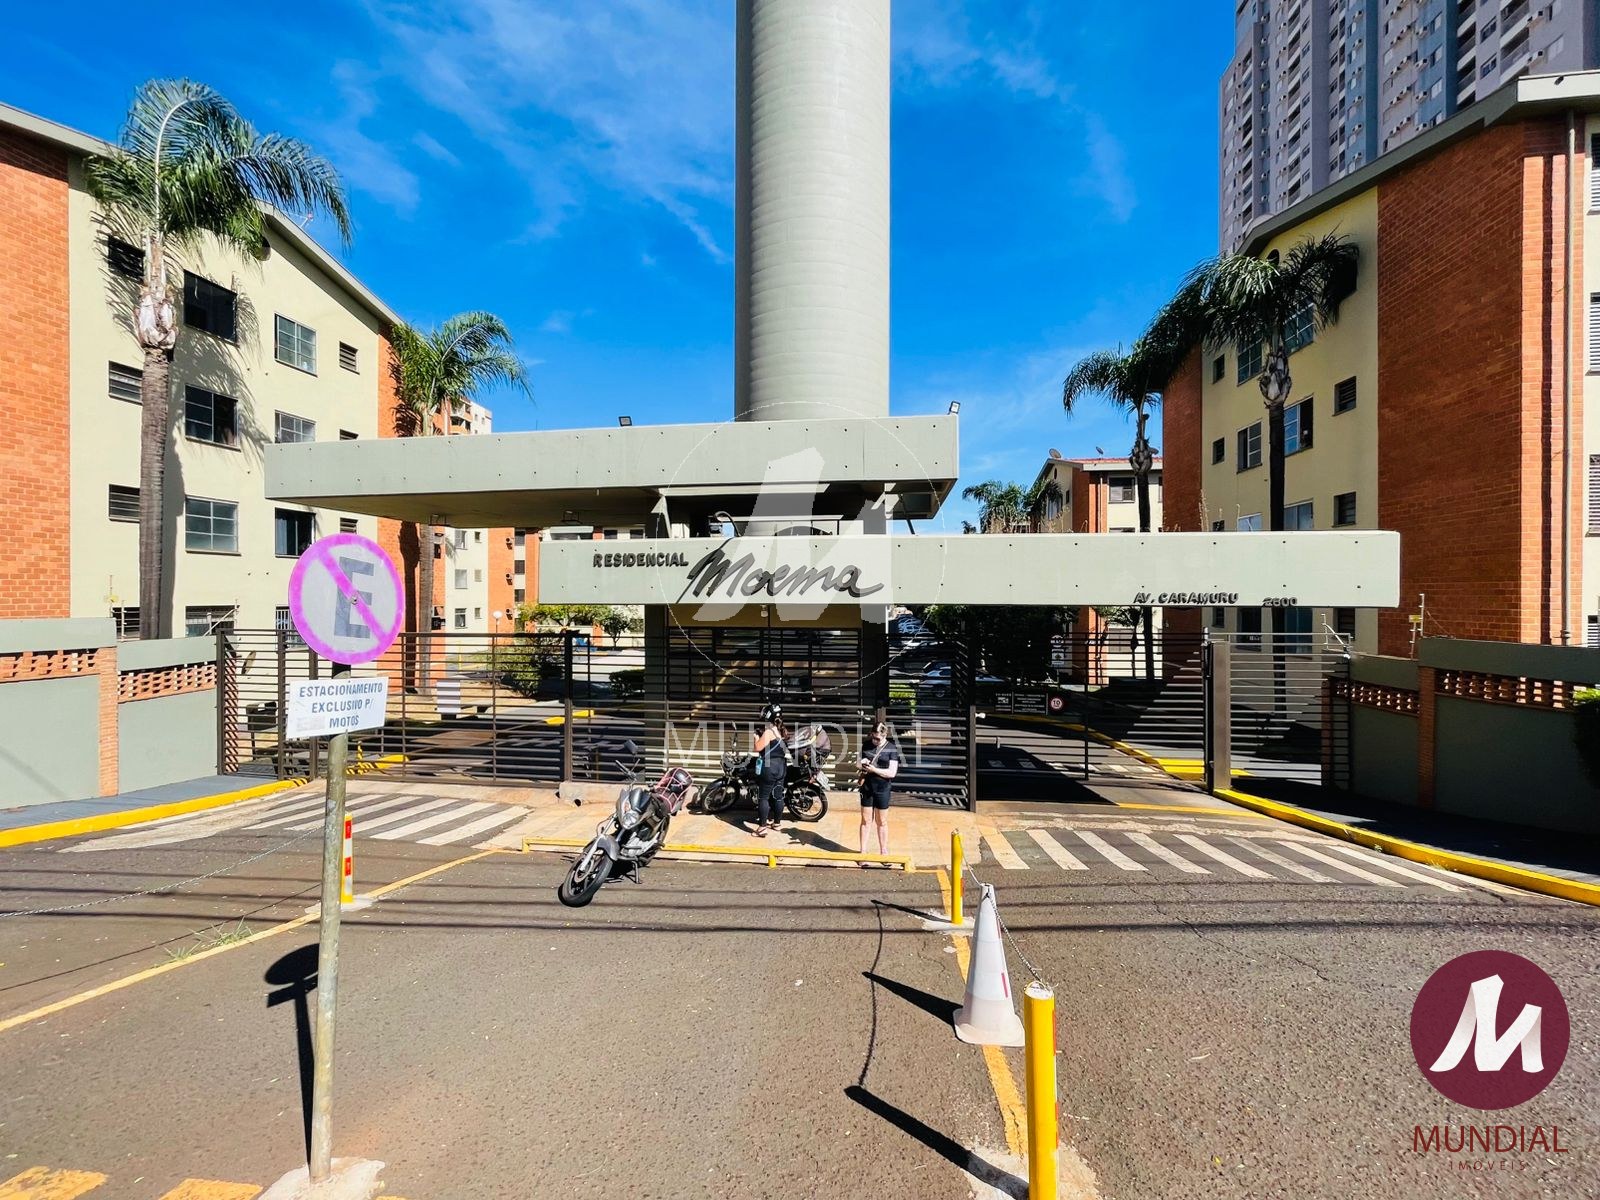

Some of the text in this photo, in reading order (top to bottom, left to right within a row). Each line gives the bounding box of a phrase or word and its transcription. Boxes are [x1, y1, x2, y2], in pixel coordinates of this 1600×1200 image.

[592, 549, 885, 598] RESIDENCIAL Moema
[333, 556, 375, 639] E
[1158, 592, 1240, 605] CARAMURU
[299, 682, 383, 698] ESTACIONAMENTO
[329, 714, 360, 729] MOTOS
